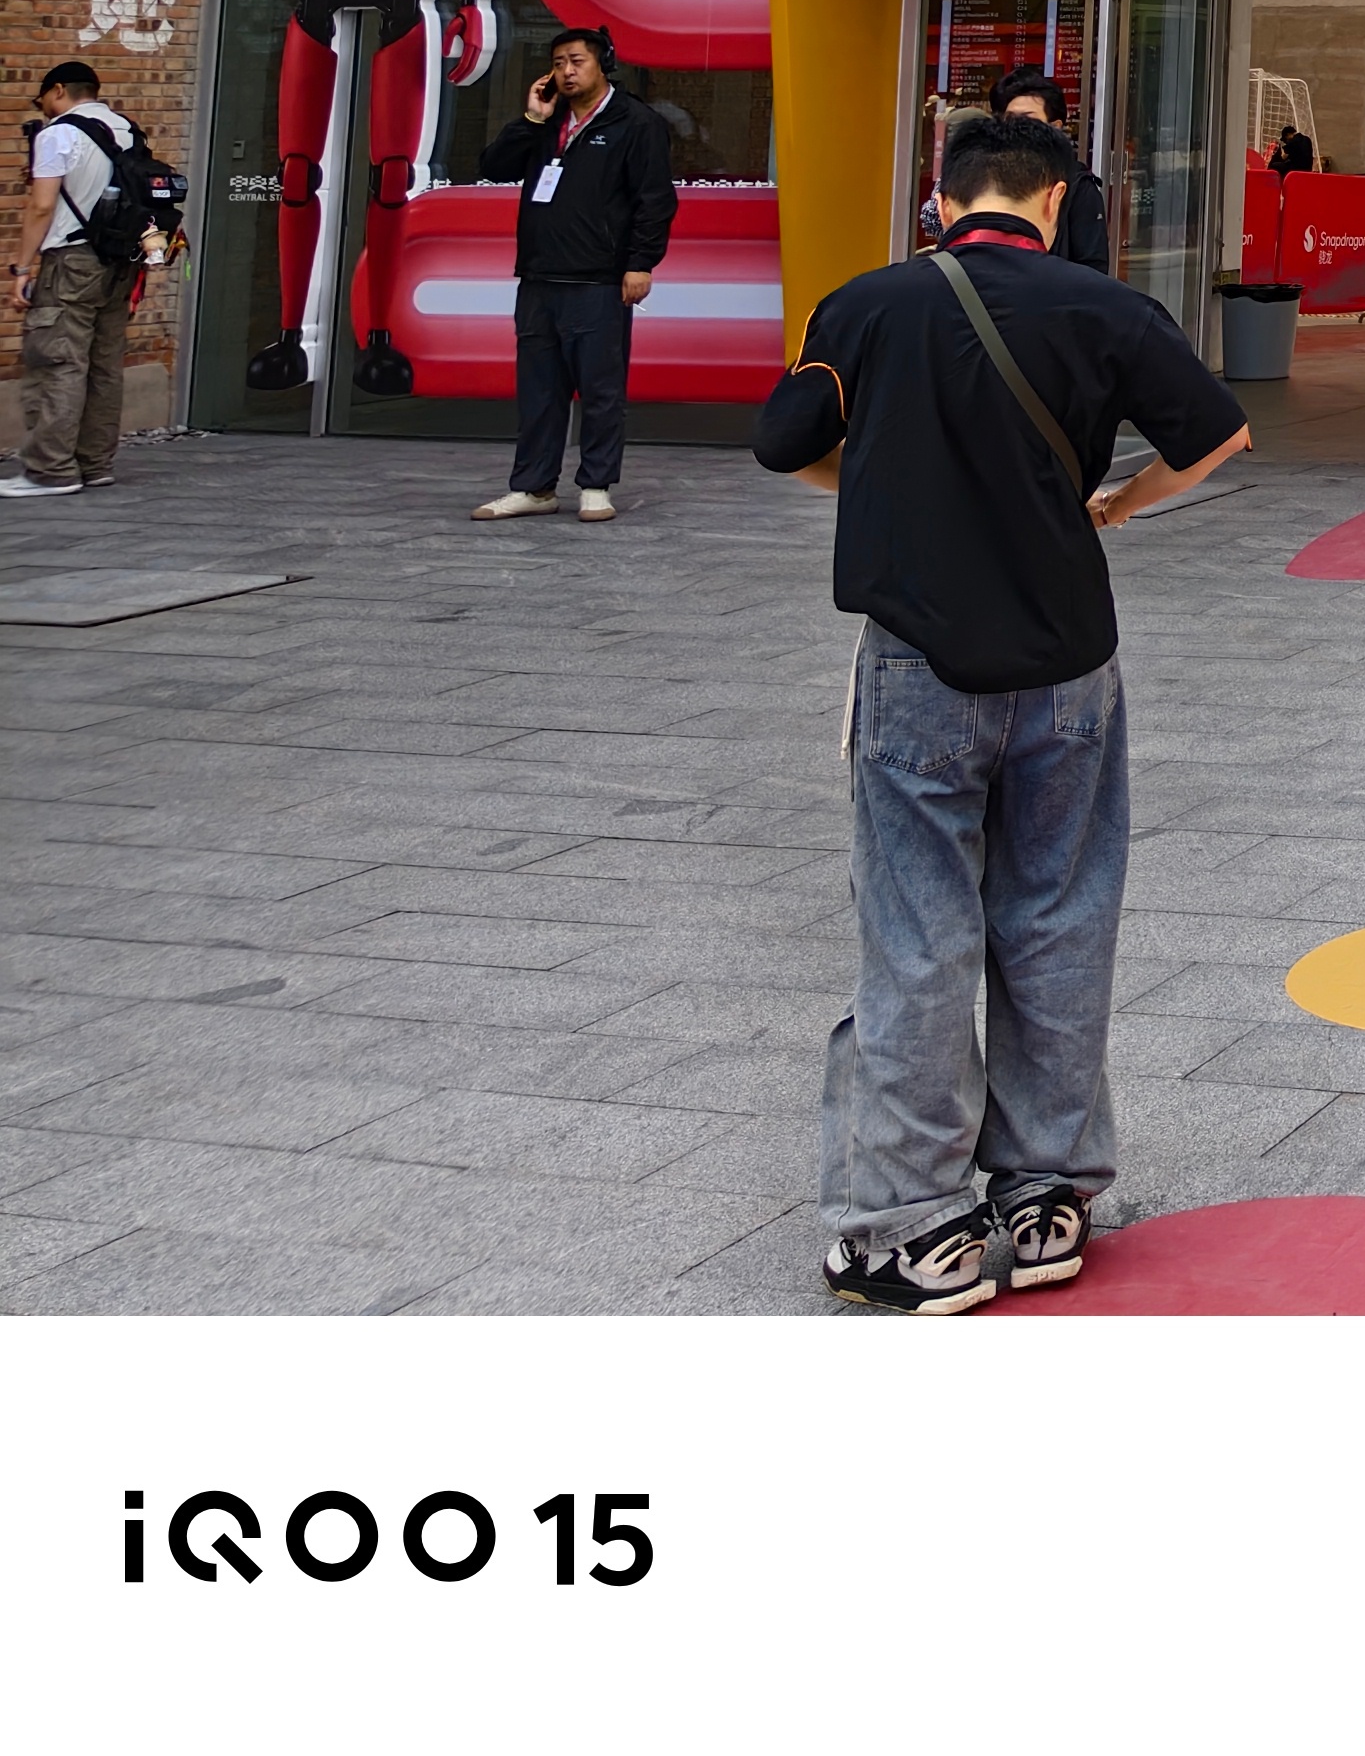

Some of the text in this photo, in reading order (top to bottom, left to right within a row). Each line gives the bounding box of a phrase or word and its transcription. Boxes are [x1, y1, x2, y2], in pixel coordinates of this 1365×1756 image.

[229, 175, 285, 192] 中央车
[229, 193, 267, 202] CENTRAL
